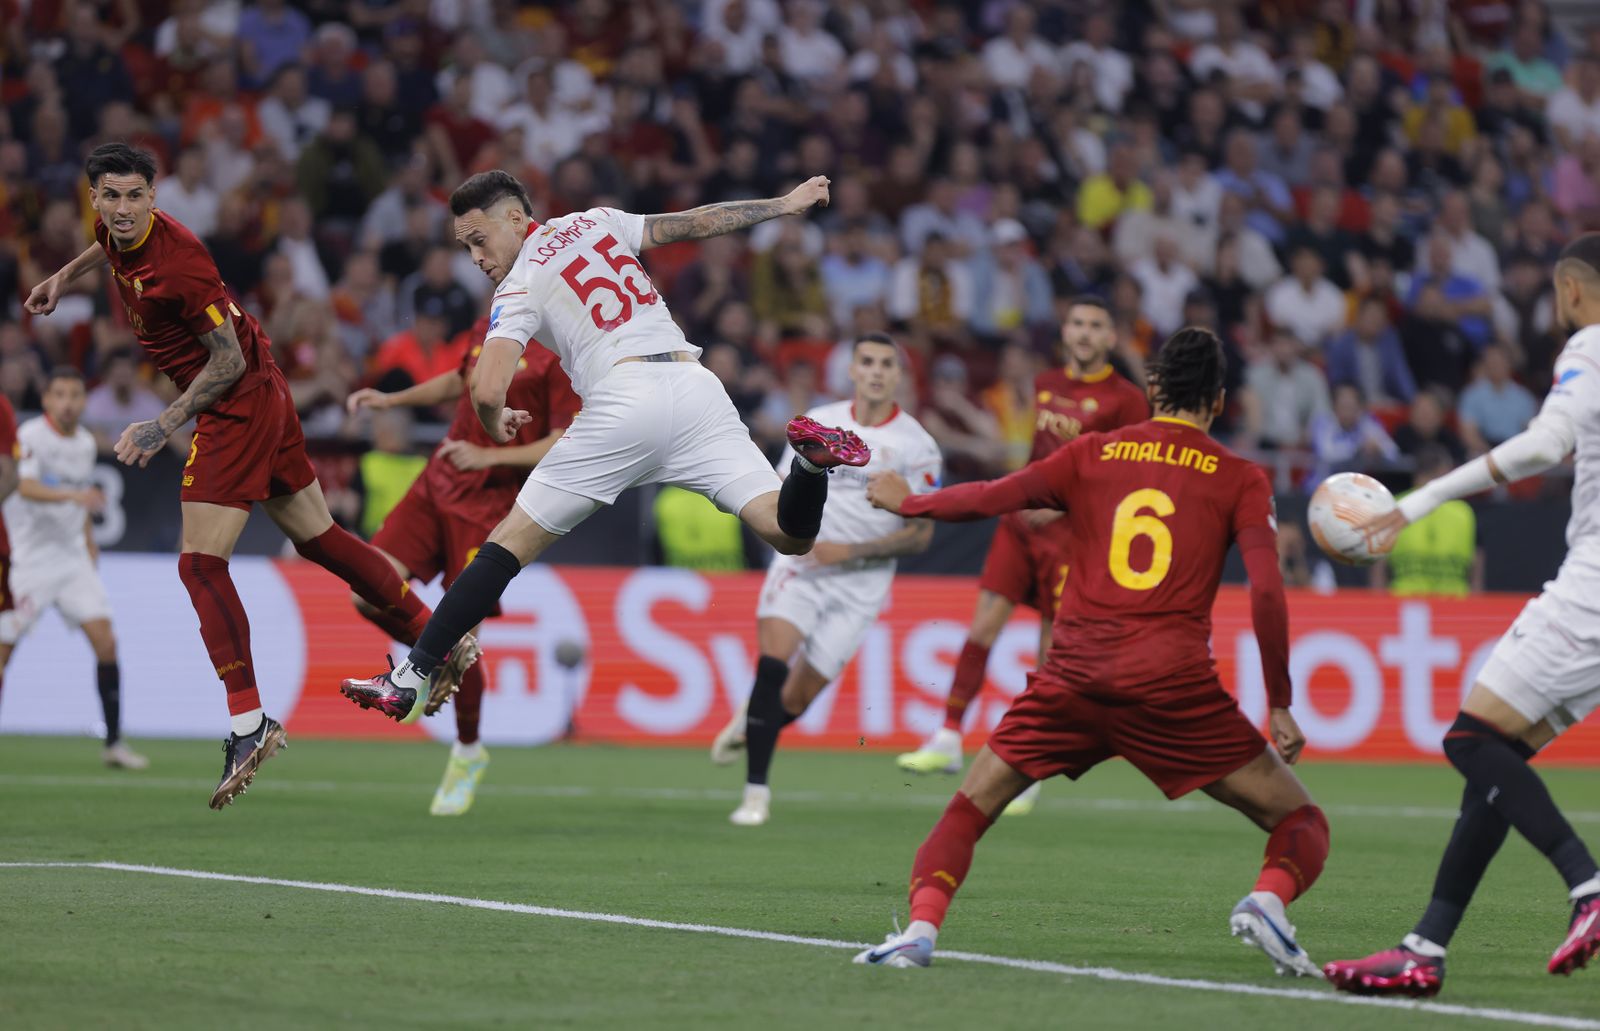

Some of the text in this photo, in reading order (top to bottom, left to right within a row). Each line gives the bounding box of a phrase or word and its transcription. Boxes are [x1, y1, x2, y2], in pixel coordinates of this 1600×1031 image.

[560, 232, 658, 333] 55
[1099, 440, 1219, 474] SMALLING
[1108, 487, 1176, 591] 6
